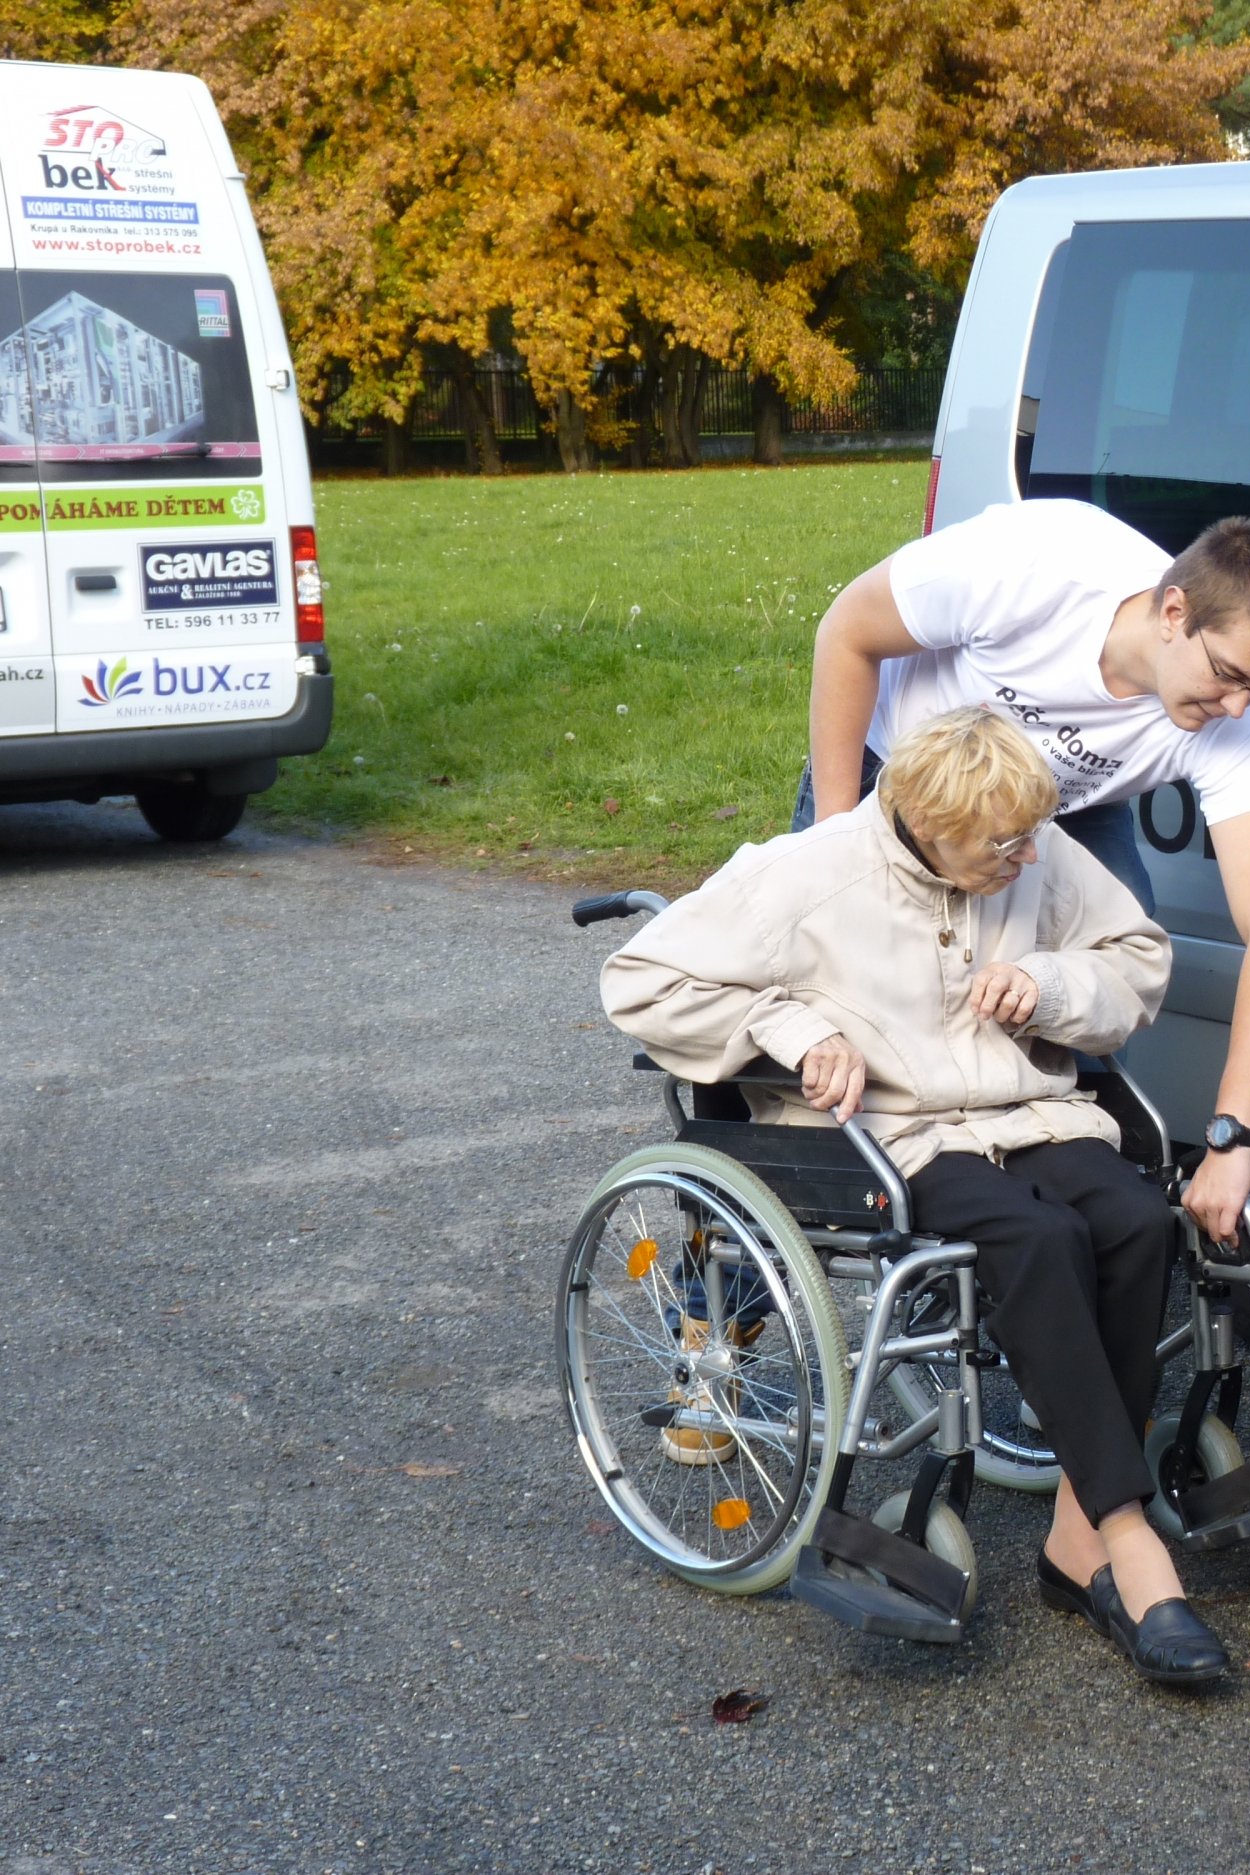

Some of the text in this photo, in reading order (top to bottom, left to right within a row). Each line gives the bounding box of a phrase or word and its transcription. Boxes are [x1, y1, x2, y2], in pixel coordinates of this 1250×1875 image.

[43, 118, 125, 147] STO
[38, 153, 127, 191] bek
[128, 183, 175, 196] systémy
[26, 200, 195, 221] KOMPLETNÍ STŘEŠNÍ SYSTÉMY
[32, 239, 201, 255] www.stoprobek.cz
[200, 317, 228, 326] RITTAL
[0, 495, 225, 521] POMÁHÁME DĚTEM
[180, 583, 193, 600] &
[233, 580, 273, 591] AGENTURA
[144, 611, 280, 630] TEL: 596 11 33 77
[153, 656, 271, 696] bux.cz
[116, 705, 154, 719] KNIHY
[165, 701, 214, 715] NÁPADY
[1050, 746, 1076, 768] vaše
